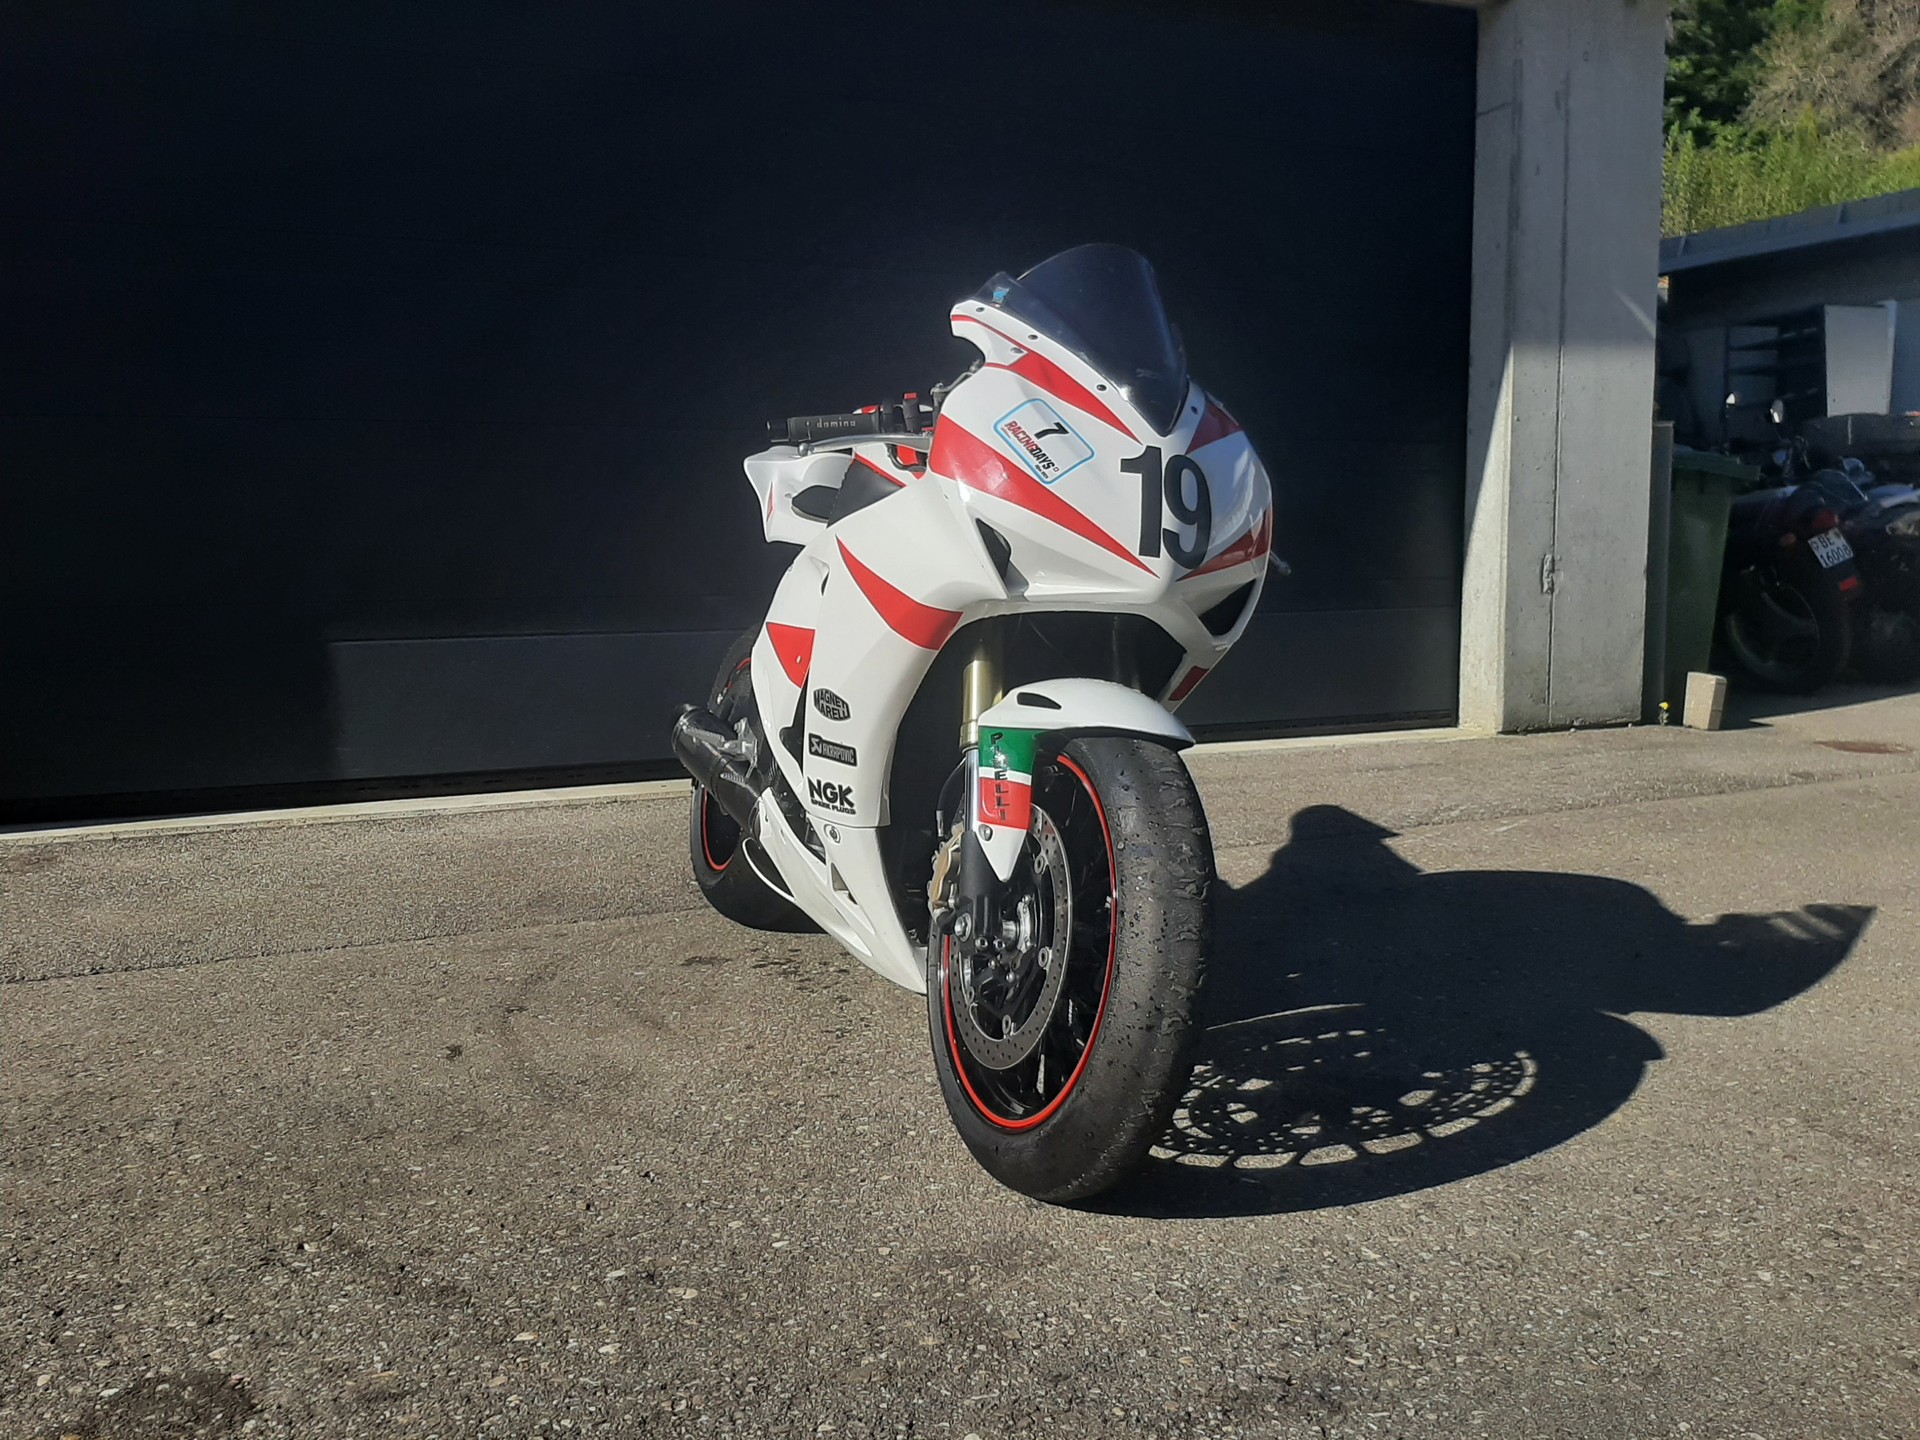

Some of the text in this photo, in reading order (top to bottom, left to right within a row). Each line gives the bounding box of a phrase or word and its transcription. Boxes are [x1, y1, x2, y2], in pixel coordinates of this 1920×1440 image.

[1033, 422, 1069, 440] 7
[1120, 445, 1212, 570] 19
[807, 776, 854, 808] NGK
